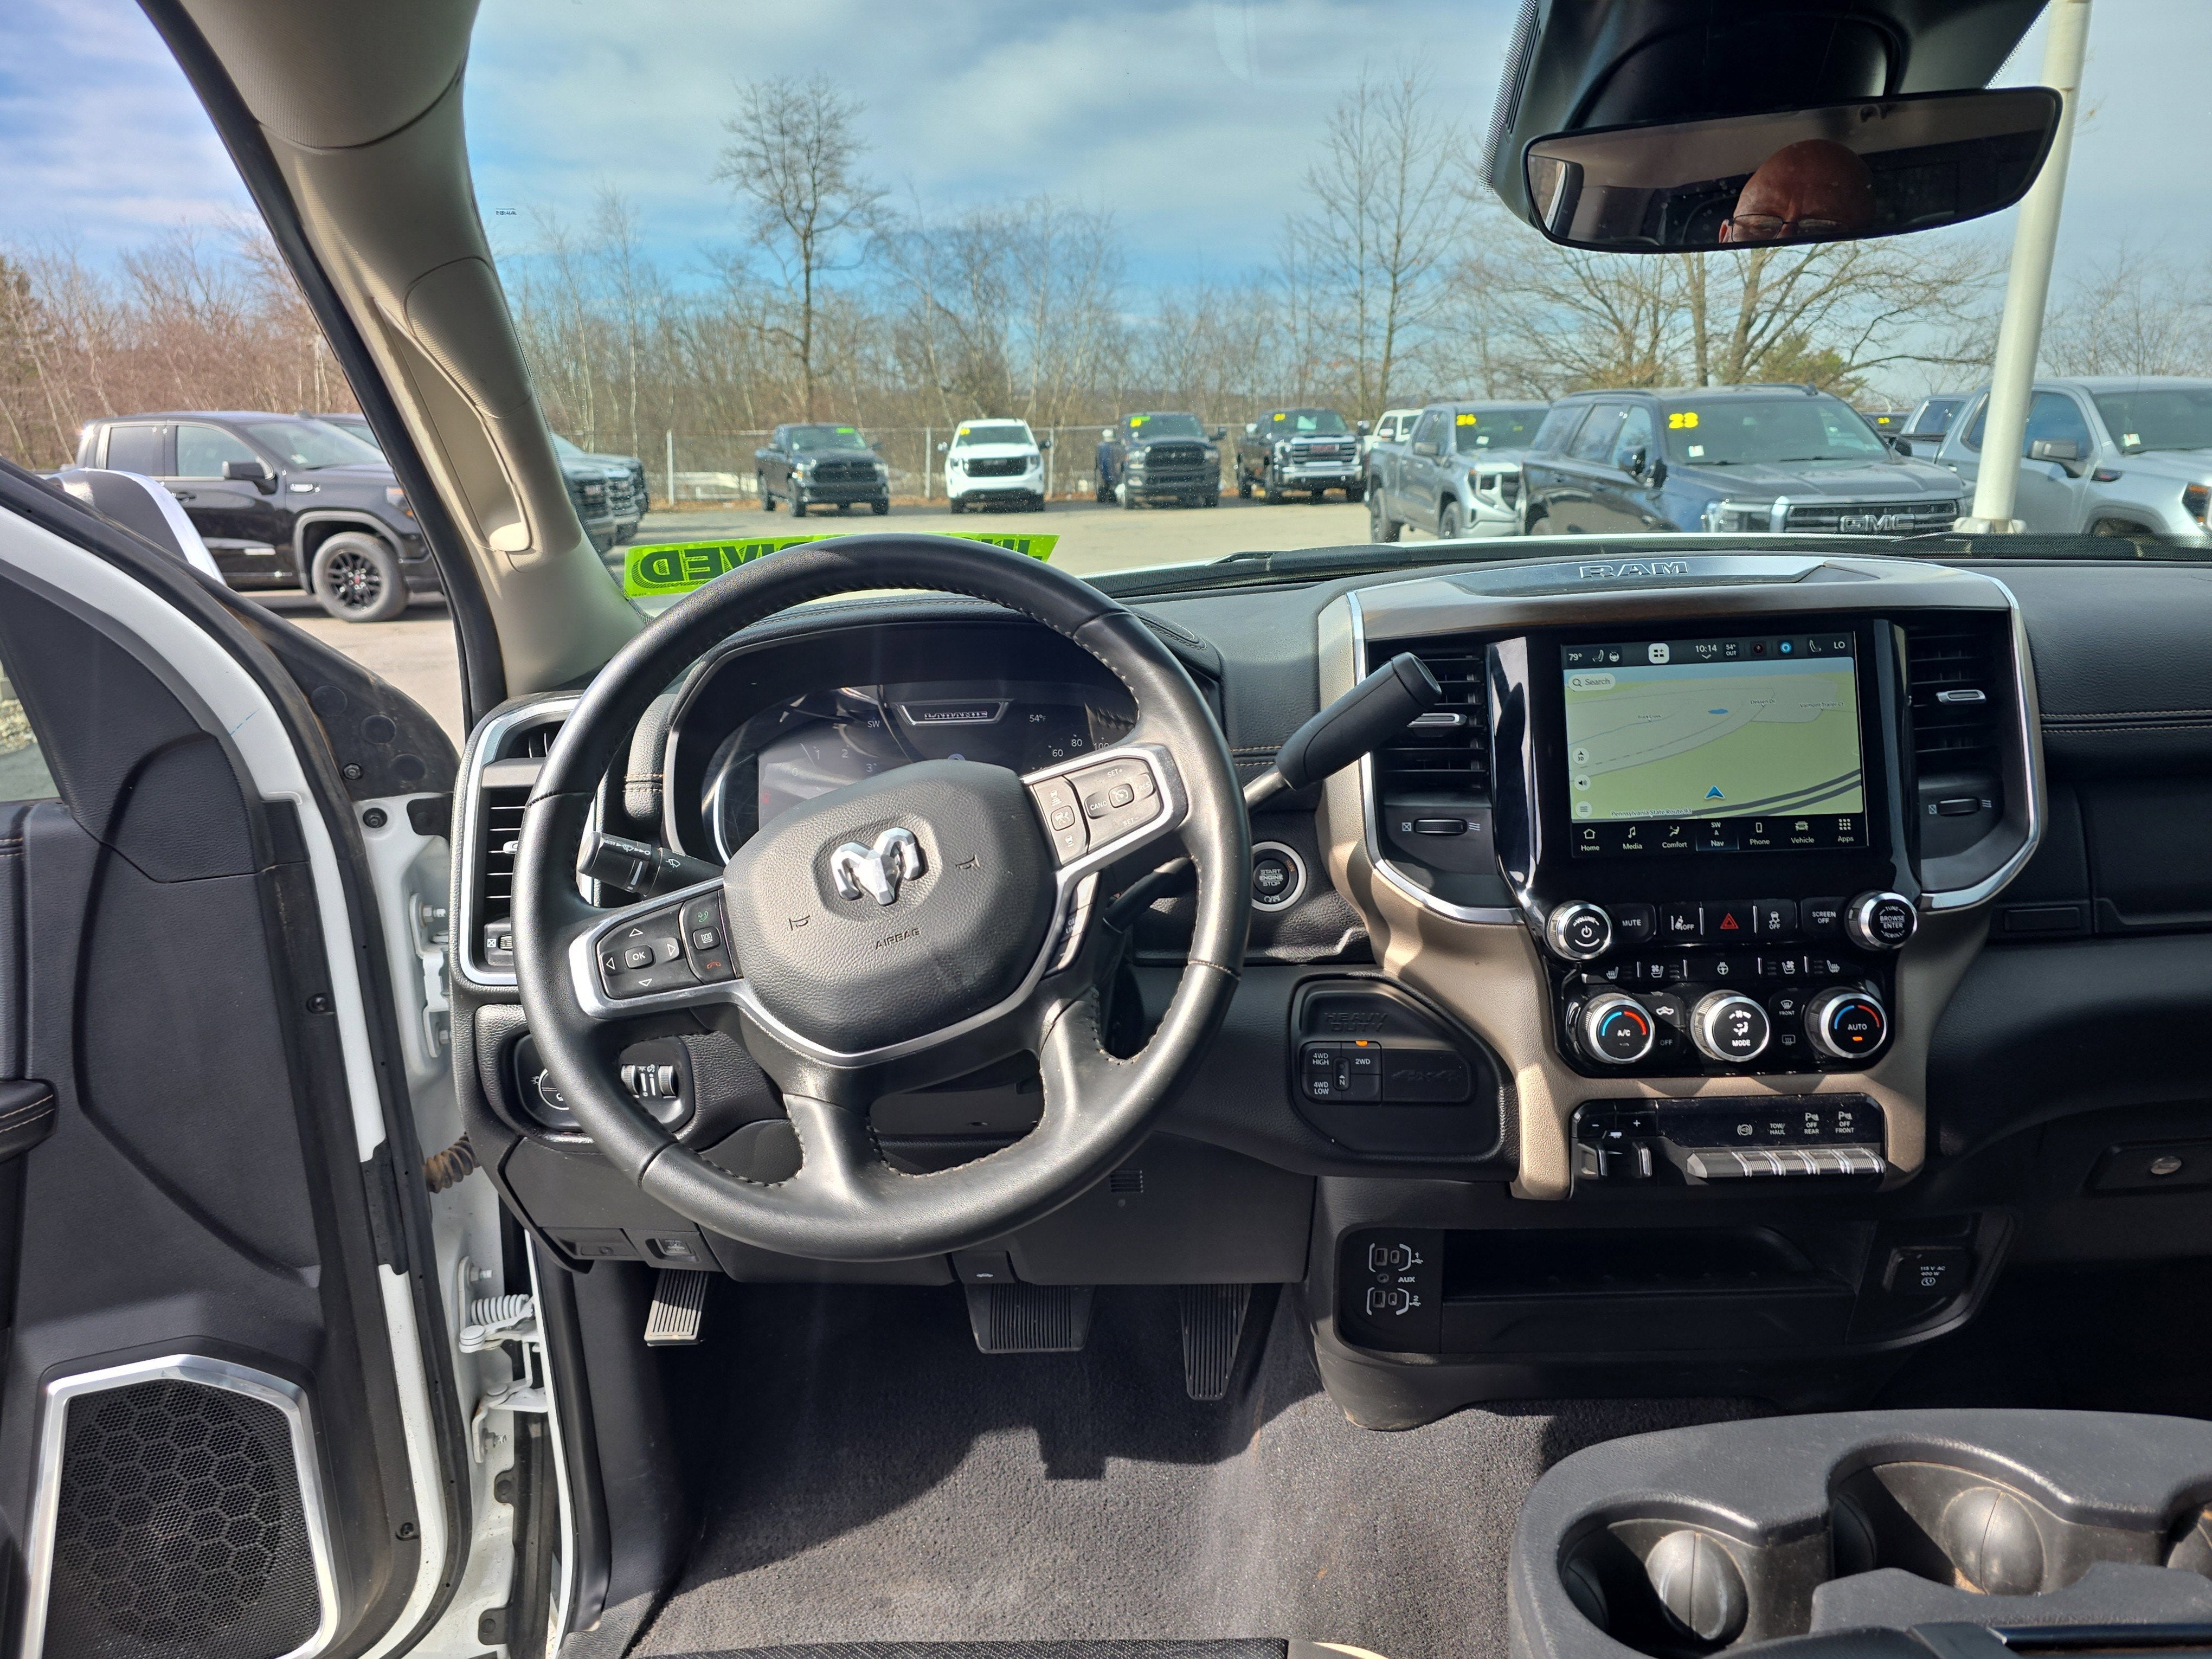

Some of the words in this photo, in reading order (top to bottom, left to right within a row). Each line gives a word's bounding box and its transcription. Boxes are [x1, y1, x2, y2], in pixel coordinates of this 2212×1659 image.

[1840, 514, 1914, 532] GMC
[1579, 561, 1688, 578] RAM
[1695, 644, 1718, 653] 10:14
[1568, 653, 1582, 661] 79°
[815, 749, 820, 760] 1
[841, 749, 849, 758] 2
[792, 768, 799, 776] 0
[866, 763, 873, 773] 3
[632, 953, 646, 961] OK
